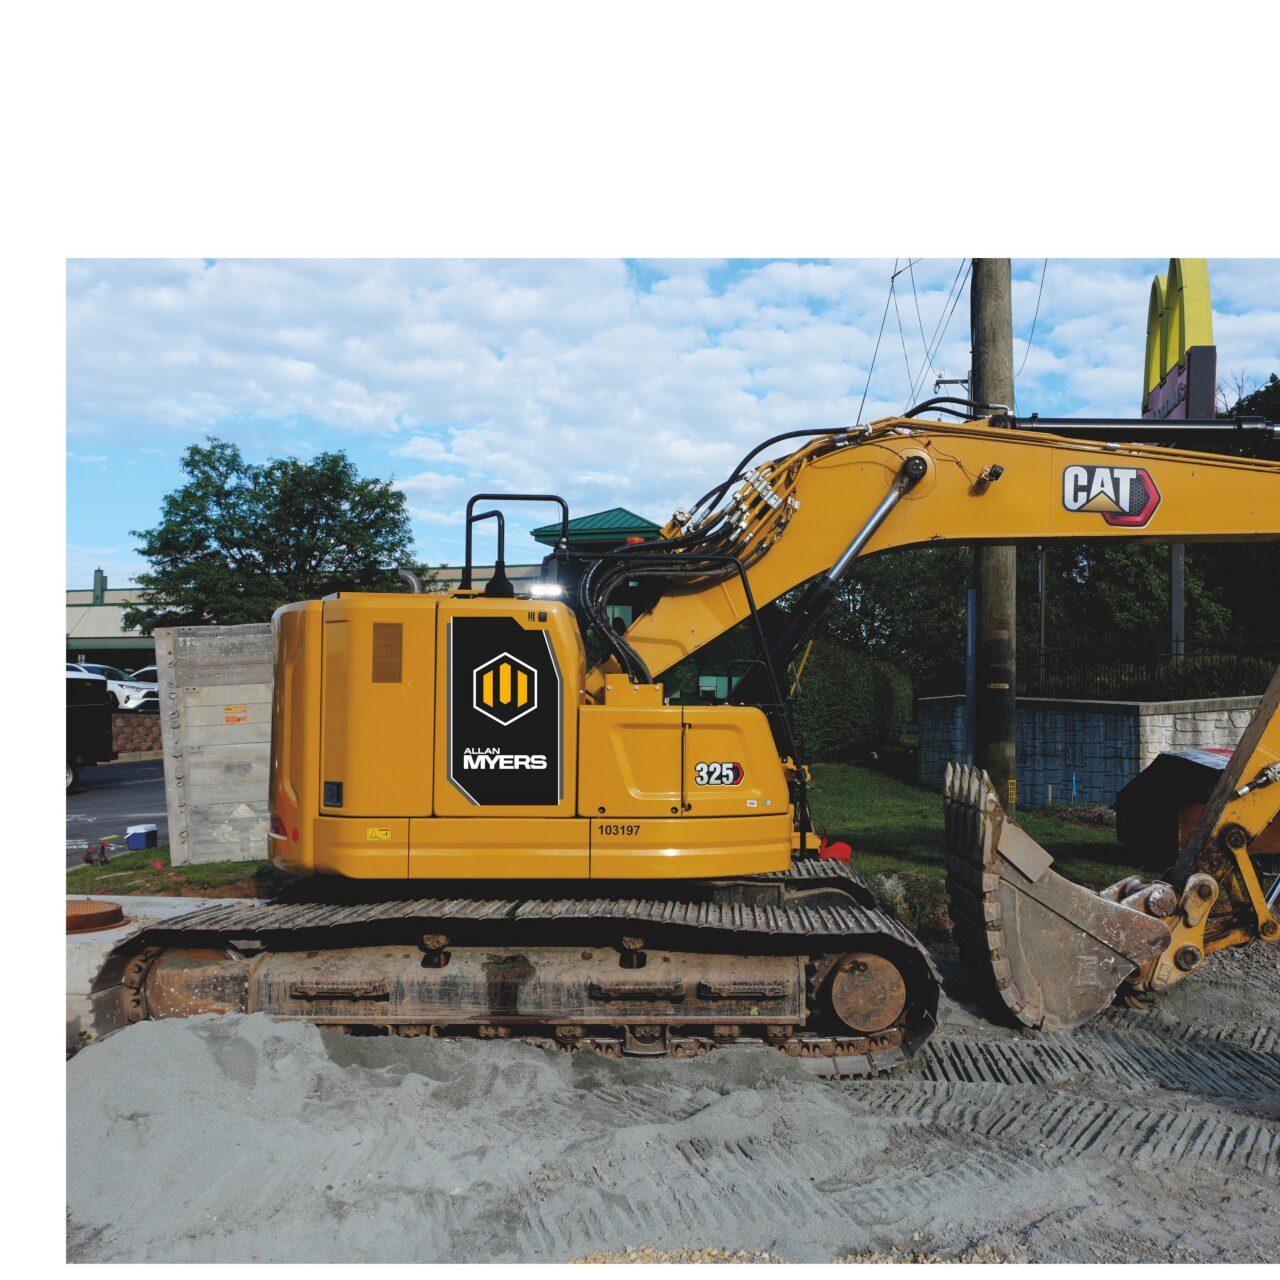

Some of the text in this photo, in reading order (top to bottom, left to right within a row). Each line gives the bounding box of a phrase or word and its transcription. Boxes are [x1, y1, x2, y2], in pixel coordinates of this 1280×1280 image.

[1064, 465, 1137, 513] CAT
[463, 747, 501, 755] ALLAN
[463, 754, 548, 770] MYERS
[695, 762, 735, 785] 325
[598, 825, 641, 836] 103197
